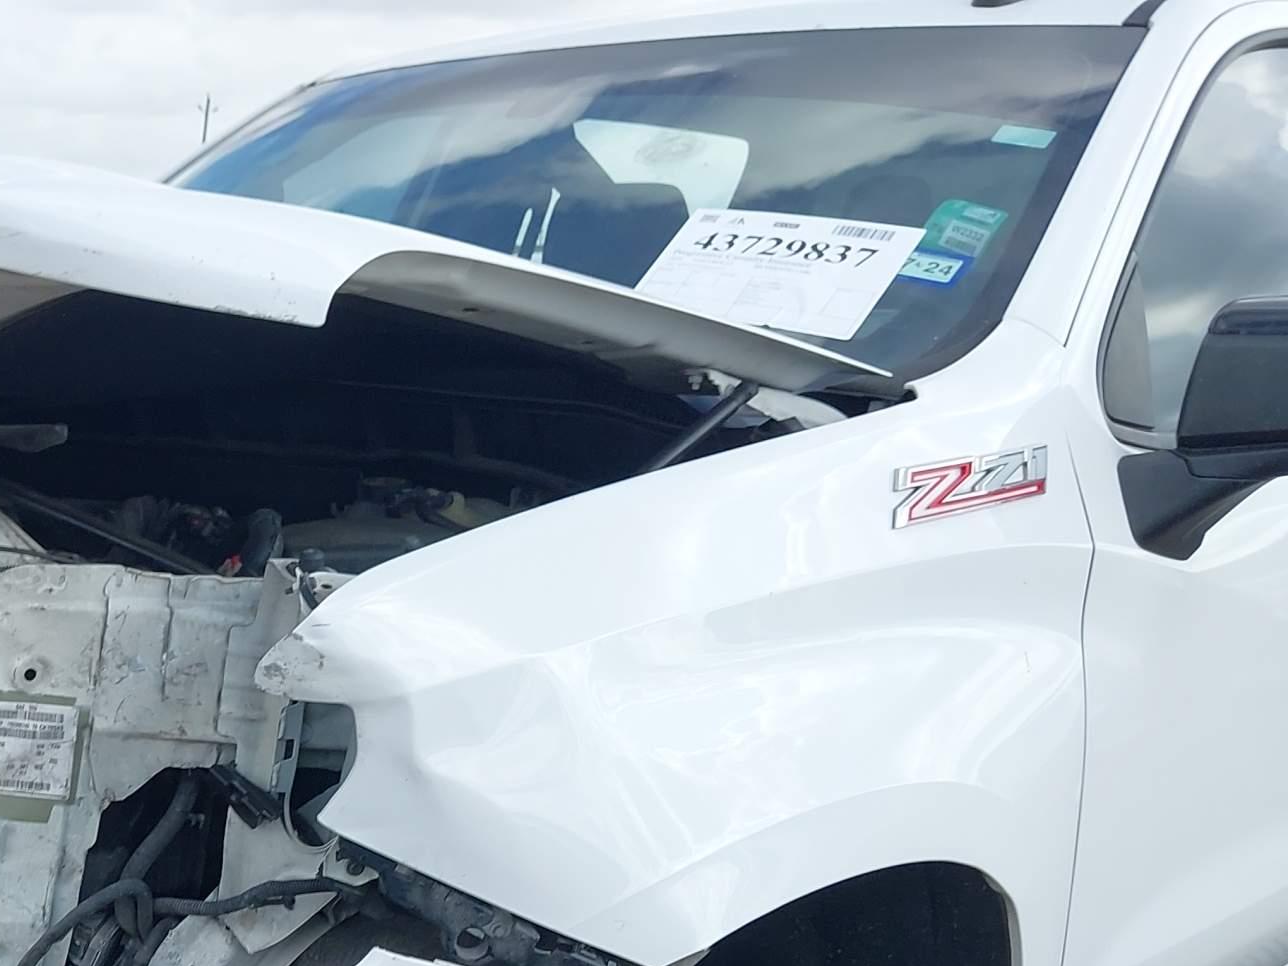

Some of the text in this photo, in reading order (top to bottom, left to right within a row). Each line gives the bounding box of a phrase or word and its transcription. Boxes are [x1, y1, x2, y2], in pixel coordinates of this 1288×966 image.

[693, 231, 880, 268] 43729837
[923, 261, 953, 277] 24
[891, 443, 1048, 529] Z71
